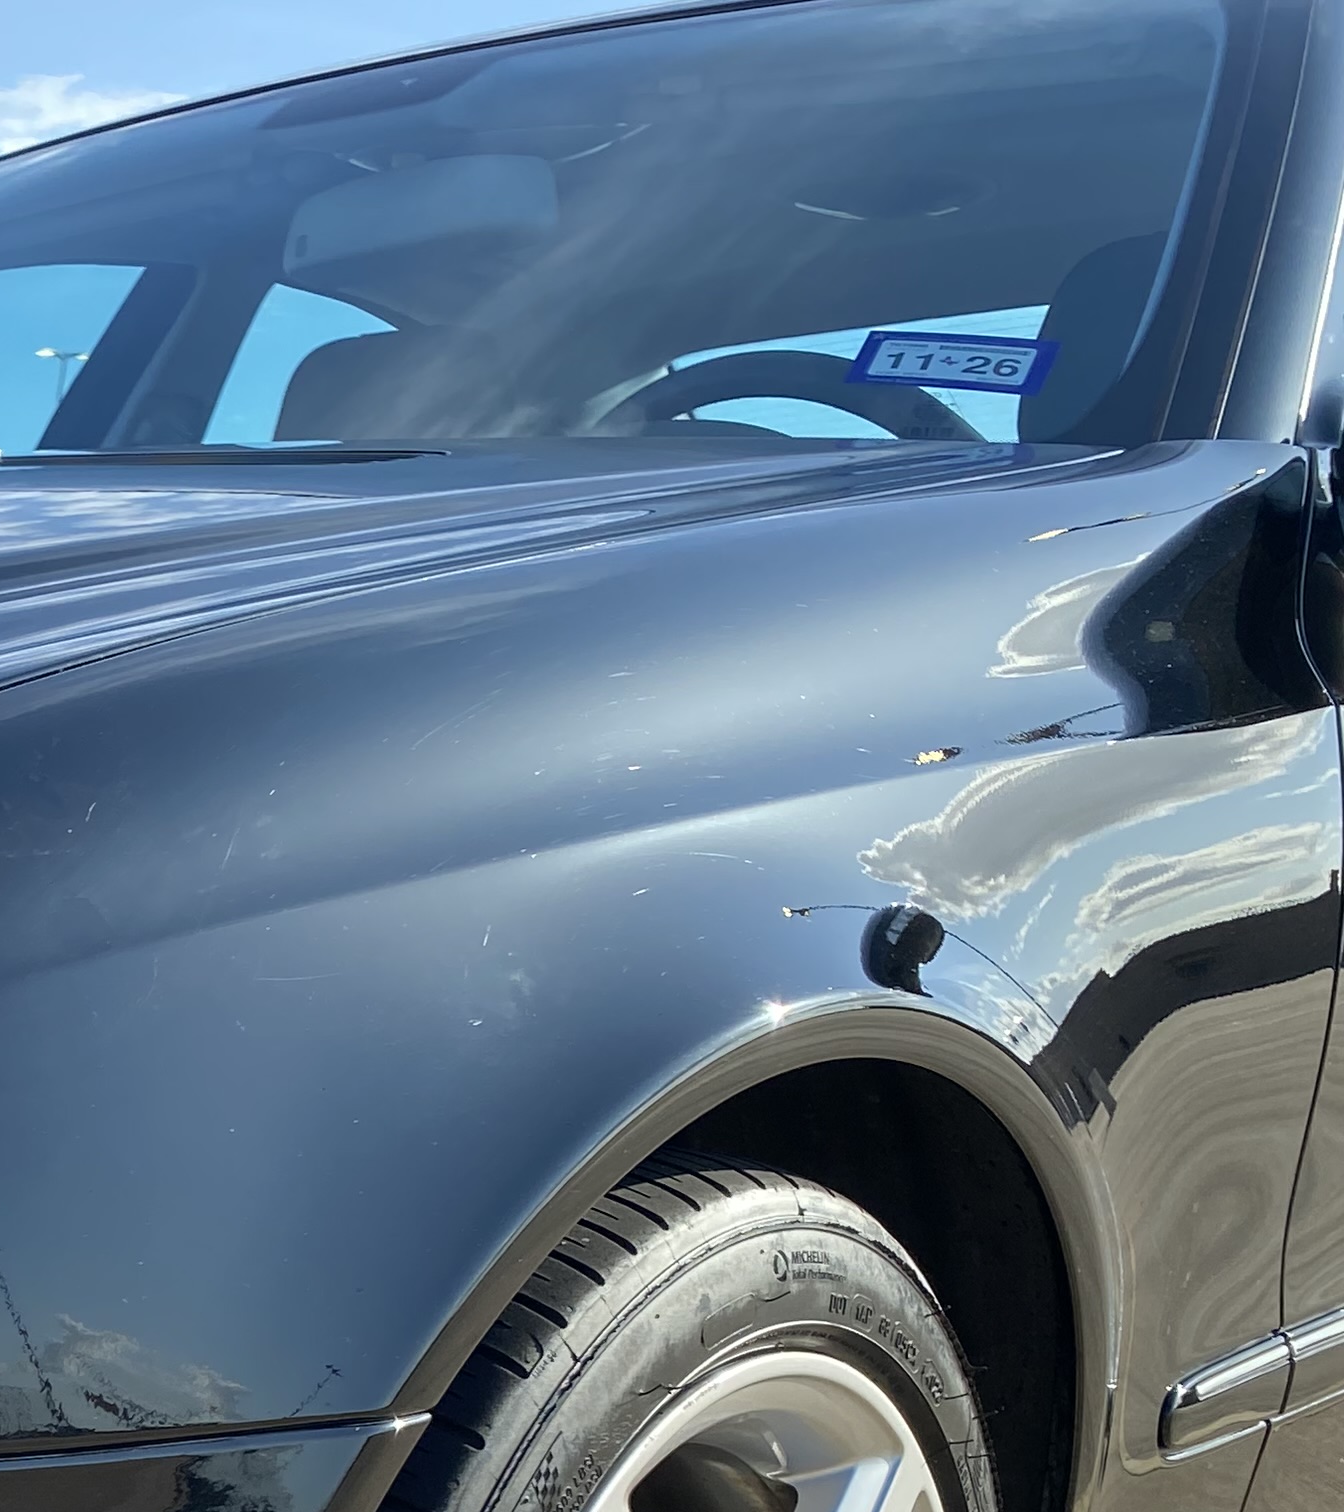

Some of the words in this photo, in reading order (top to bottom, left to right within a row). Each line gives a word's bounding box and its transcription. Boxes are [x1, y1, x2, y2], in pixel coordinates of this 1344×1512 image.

[886, 351, 934, 371] 11
[960, 355, 1023, 378] 26
[791, 1249, 830, 1265] MICHELIN
[791, 1267, 808, 1280] Total
[829, 1293, 848, 1316] DOT
